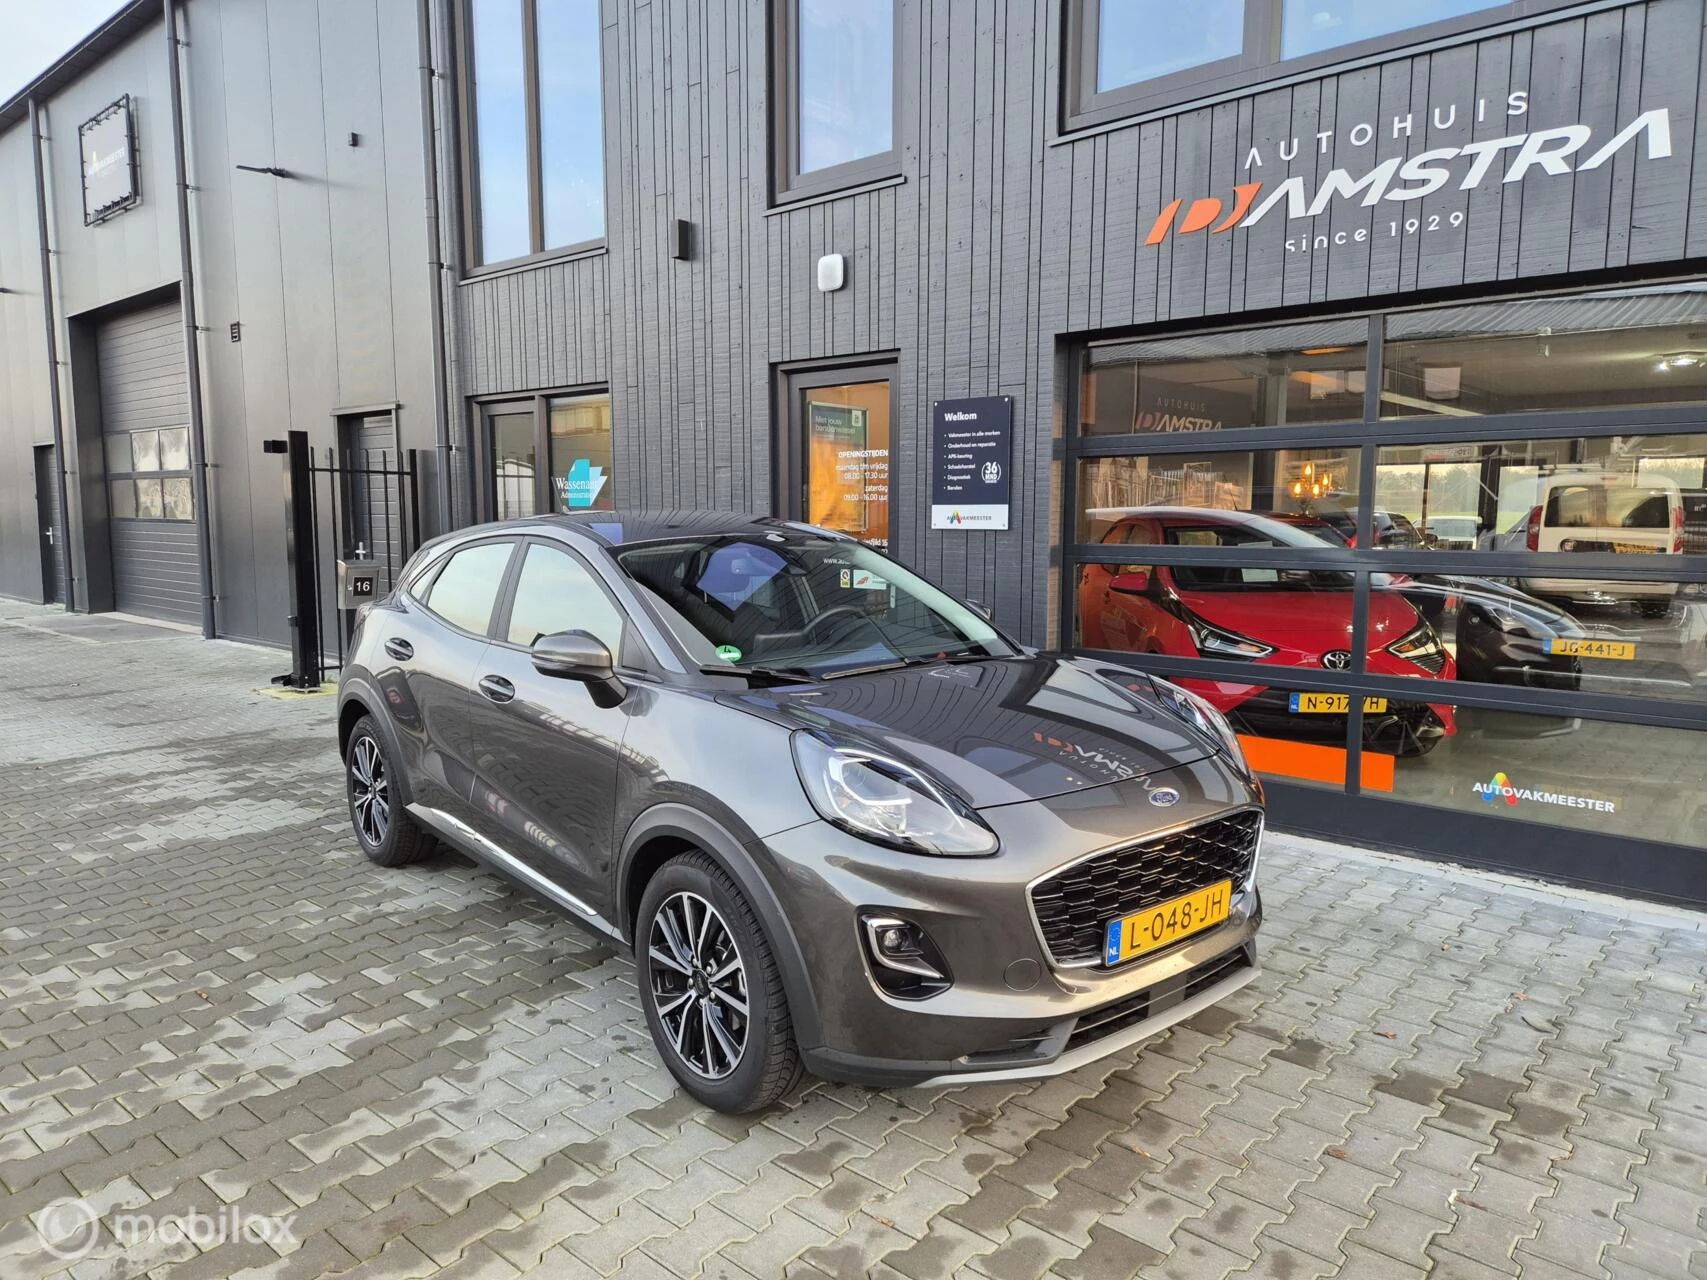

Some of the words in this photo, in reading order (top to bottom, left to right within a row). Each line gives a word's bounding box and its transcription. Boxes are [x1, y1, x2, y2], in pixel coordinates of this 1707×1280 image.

[1245, 91, 1529, 169] AUTOHUIS
[1284, 228, 1368, 253] since
[1389, 211, 1465, 239] 1929
[1157, 396, 1207, 413] AUTOHUIS
[944, 411, 978, 422] Welkom
[838, 449, 889, 458] OPENINGSTIJDEN
[984, 461, 998, 474] 36
[356, 581, 370, 592] 16
[1559, 640, 1625, 657] JG-441-J
[1306, 696, 1379, 711] N-917H
[1472, 782, 1616, 813] AUTOVAKMEESTER
[1130, 889, 1223, 951] L-048-JH
[1109, 946, 1119, 957] NL
